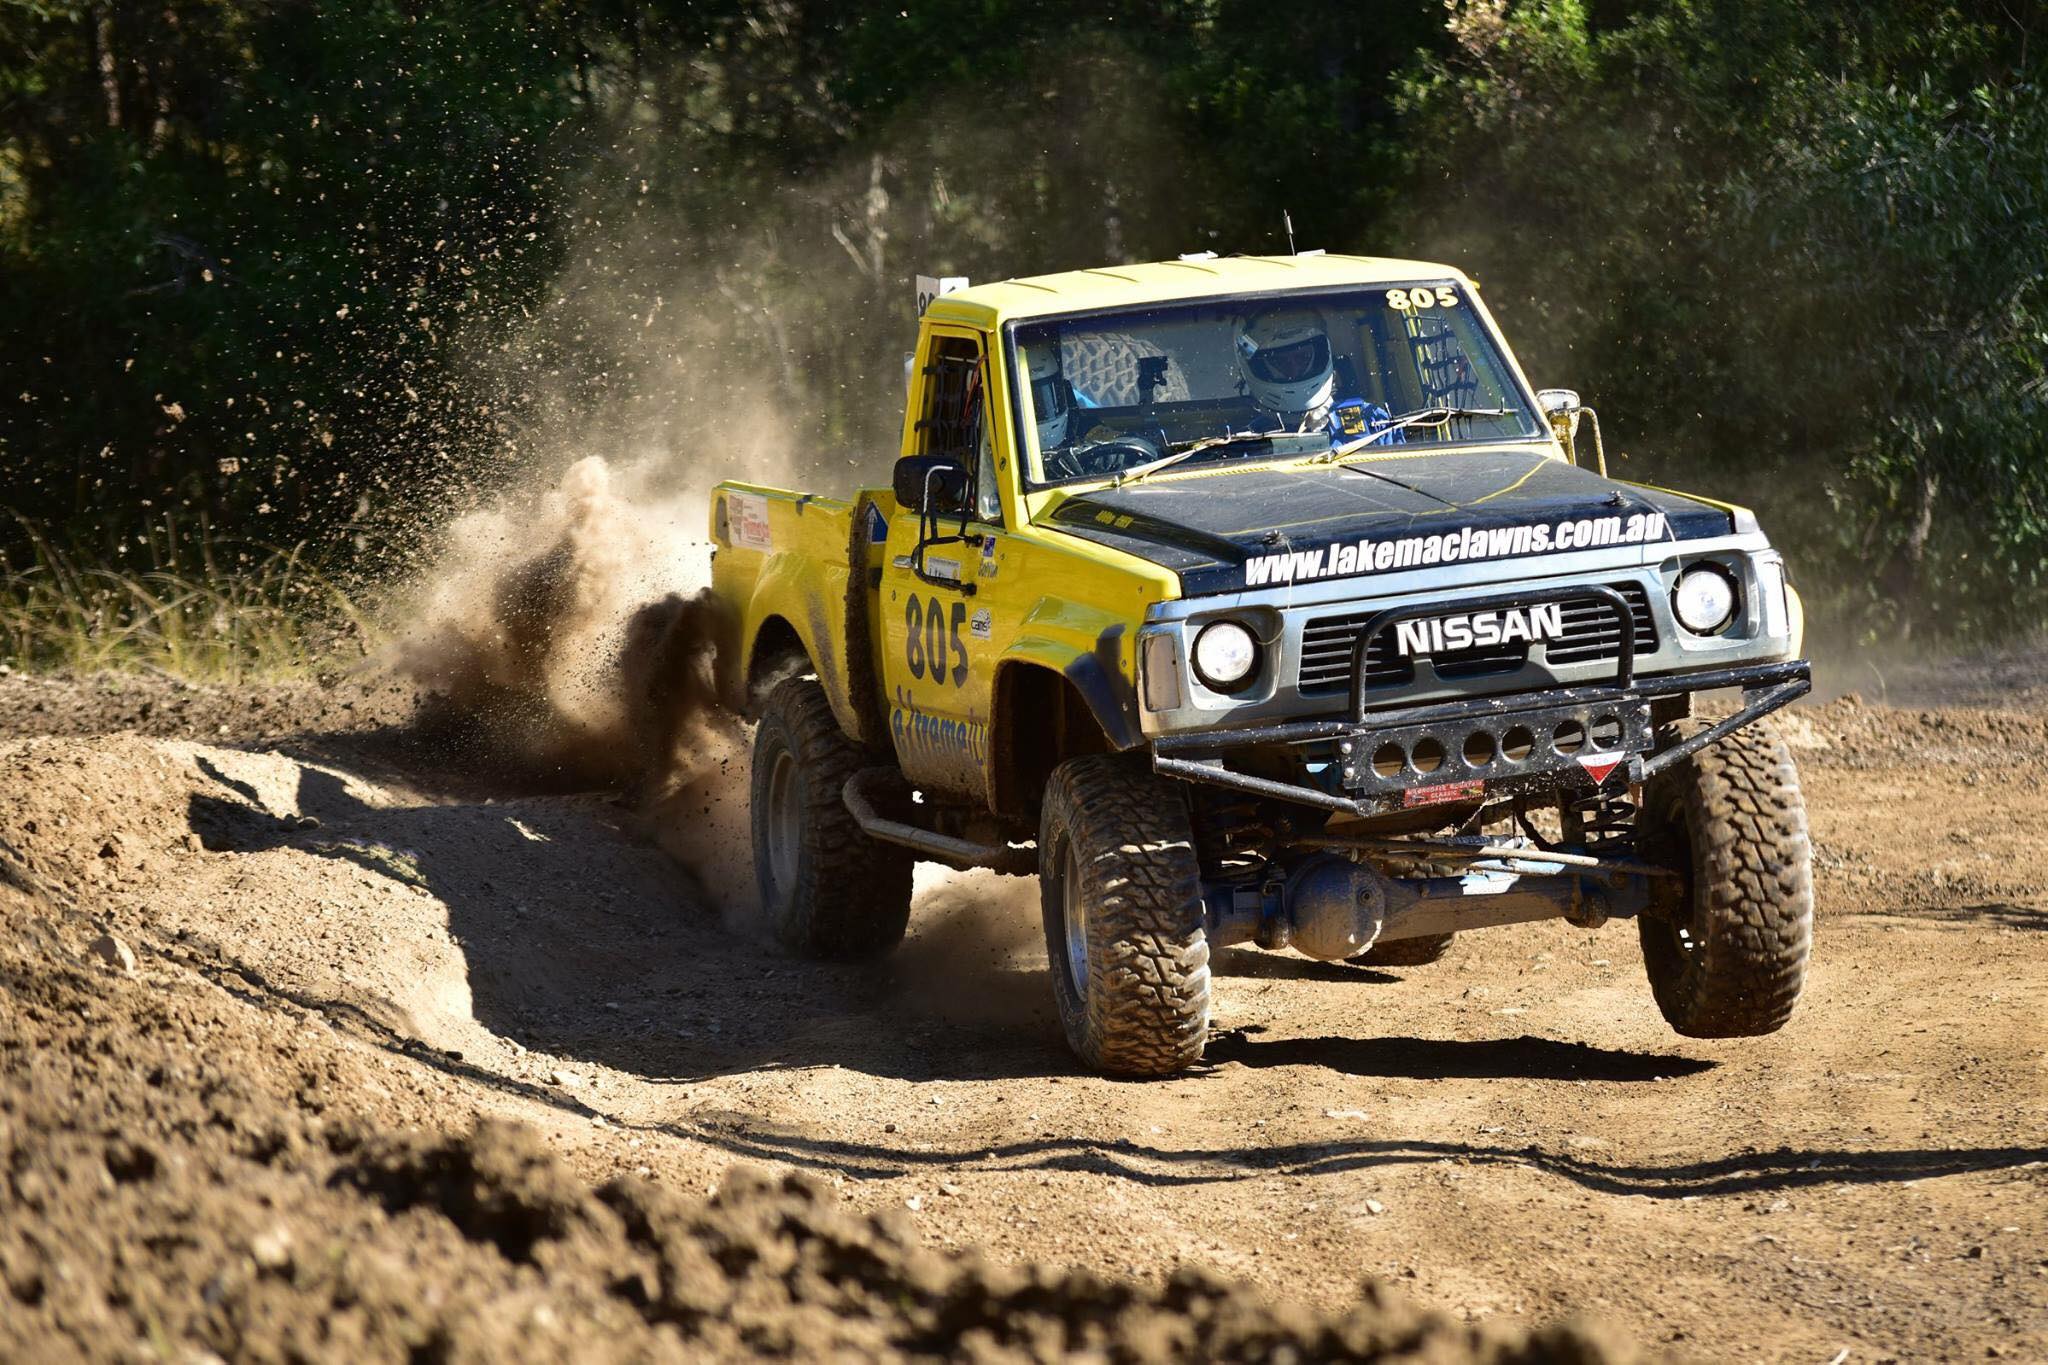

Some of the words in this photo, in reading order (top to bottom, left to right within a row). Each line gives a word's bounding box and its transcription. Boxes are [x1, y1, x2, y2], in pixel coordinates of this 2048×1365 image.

[1386, 288, 1458, 310] 805
[1246, 513, 1665, 586] www.lakemaclawns.com.au
[906, 593, 968, 688] 805
[1395, 604, 1563, 656] NISSAN
